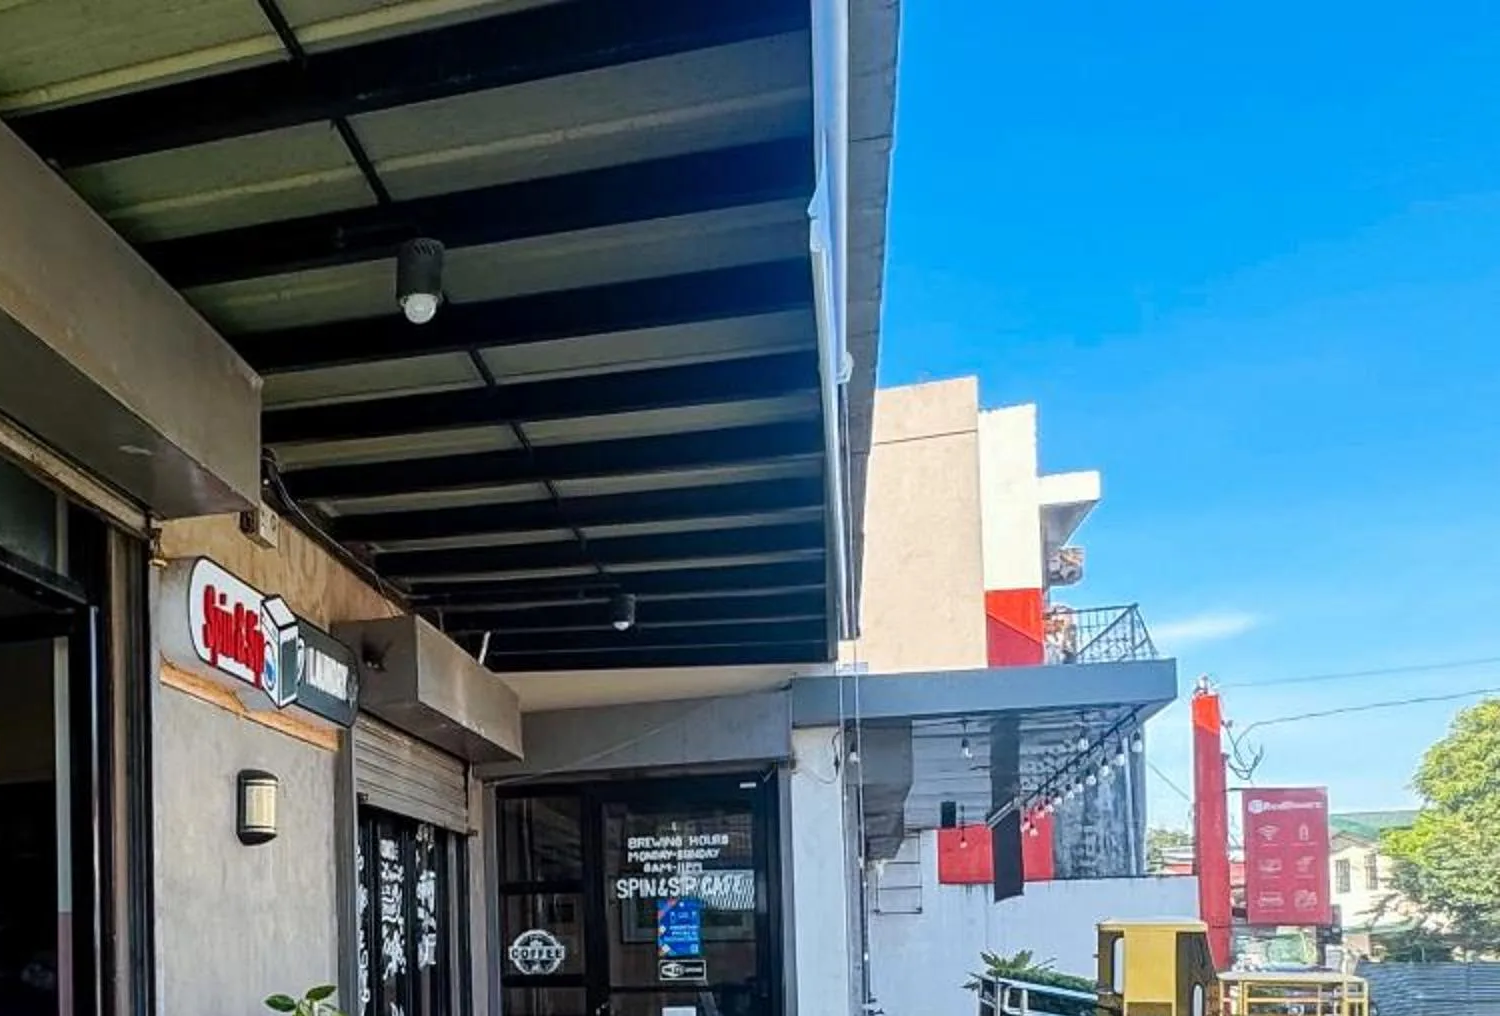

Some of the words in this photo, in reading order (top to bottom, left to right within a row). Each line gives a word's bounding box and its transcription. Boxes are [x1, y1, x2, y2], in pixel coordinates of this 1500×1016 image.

[627, 836, 682, 849] BREWING
[689, 834, 729, 846] HOURS
[511, 947, 563, 960] COFFEE
